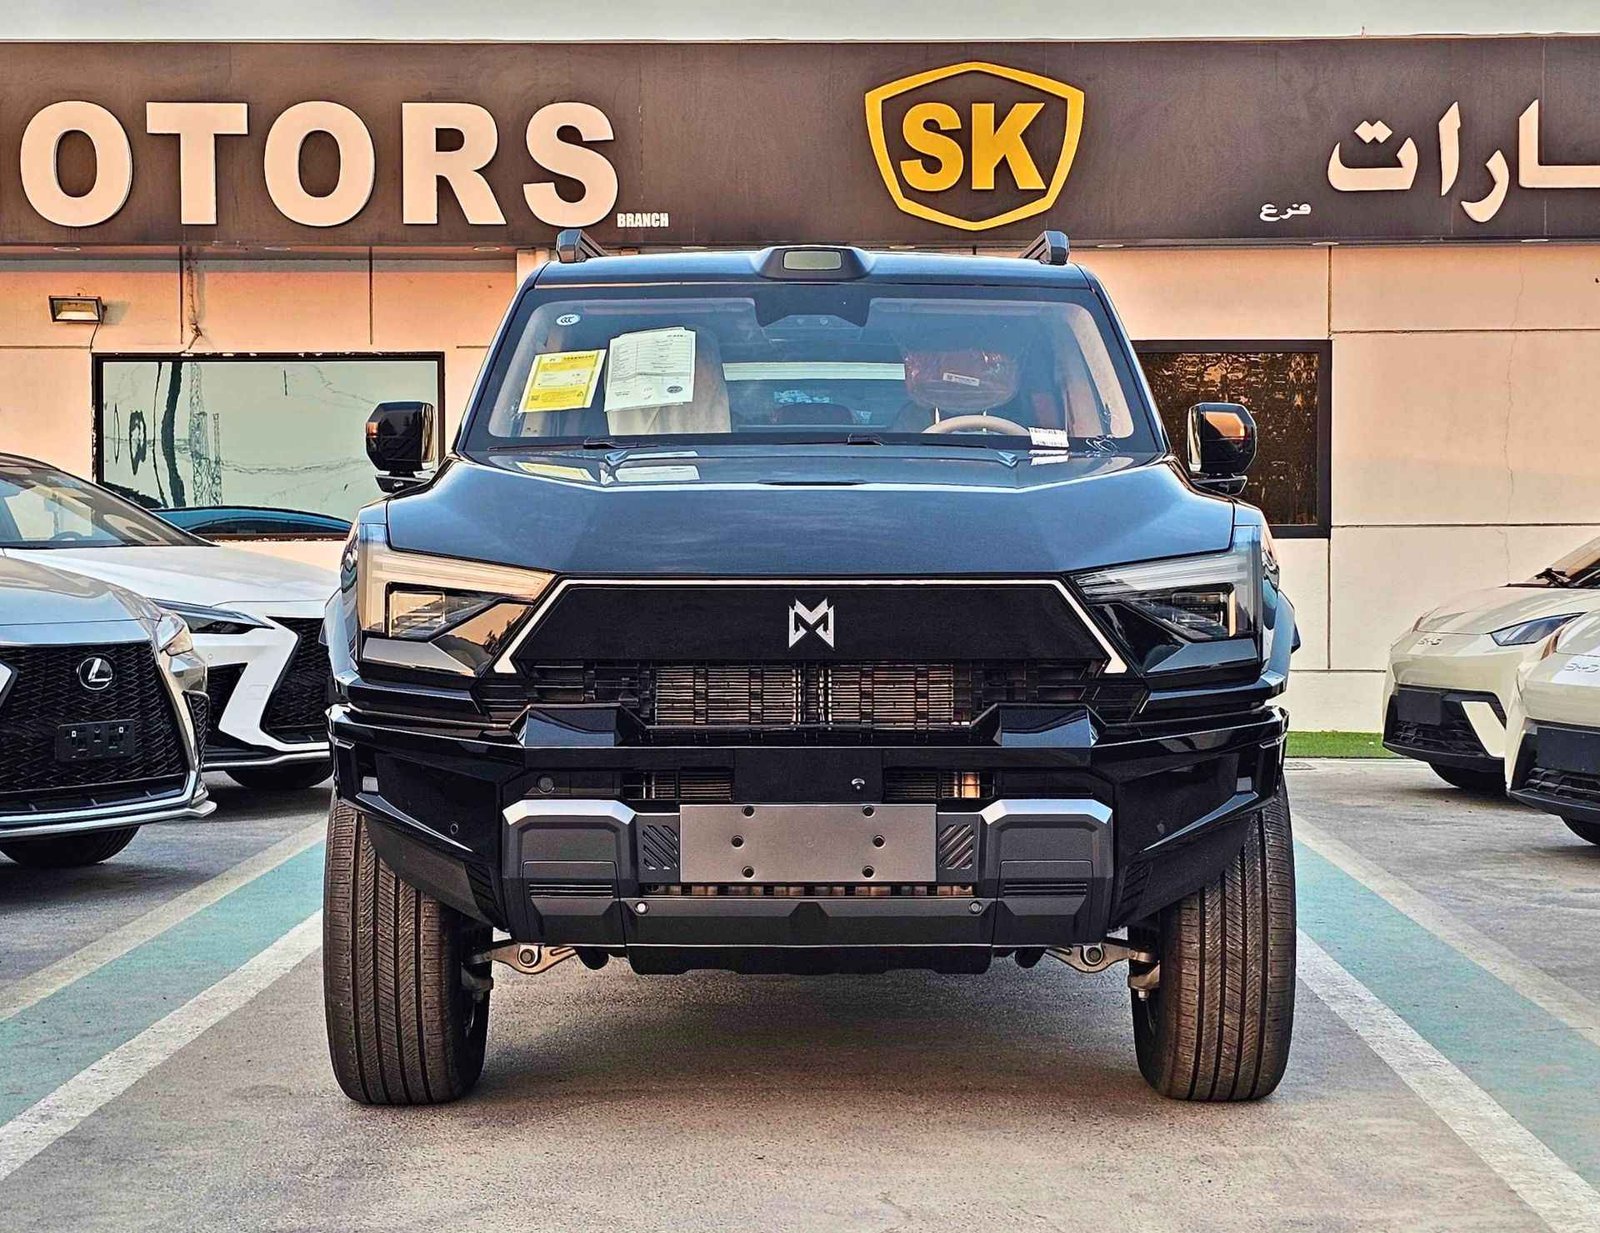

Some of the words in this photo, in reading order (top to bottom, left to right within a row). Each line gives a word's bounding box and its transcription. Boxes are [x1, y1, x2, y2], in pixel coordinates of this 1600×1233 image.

[900, 101, 1047, 193] SK
[1327, 98, 1600, 223] ارات
[616, 212, 669, 228] BRANCH
[1259, 200, 1312, 221] فرع
